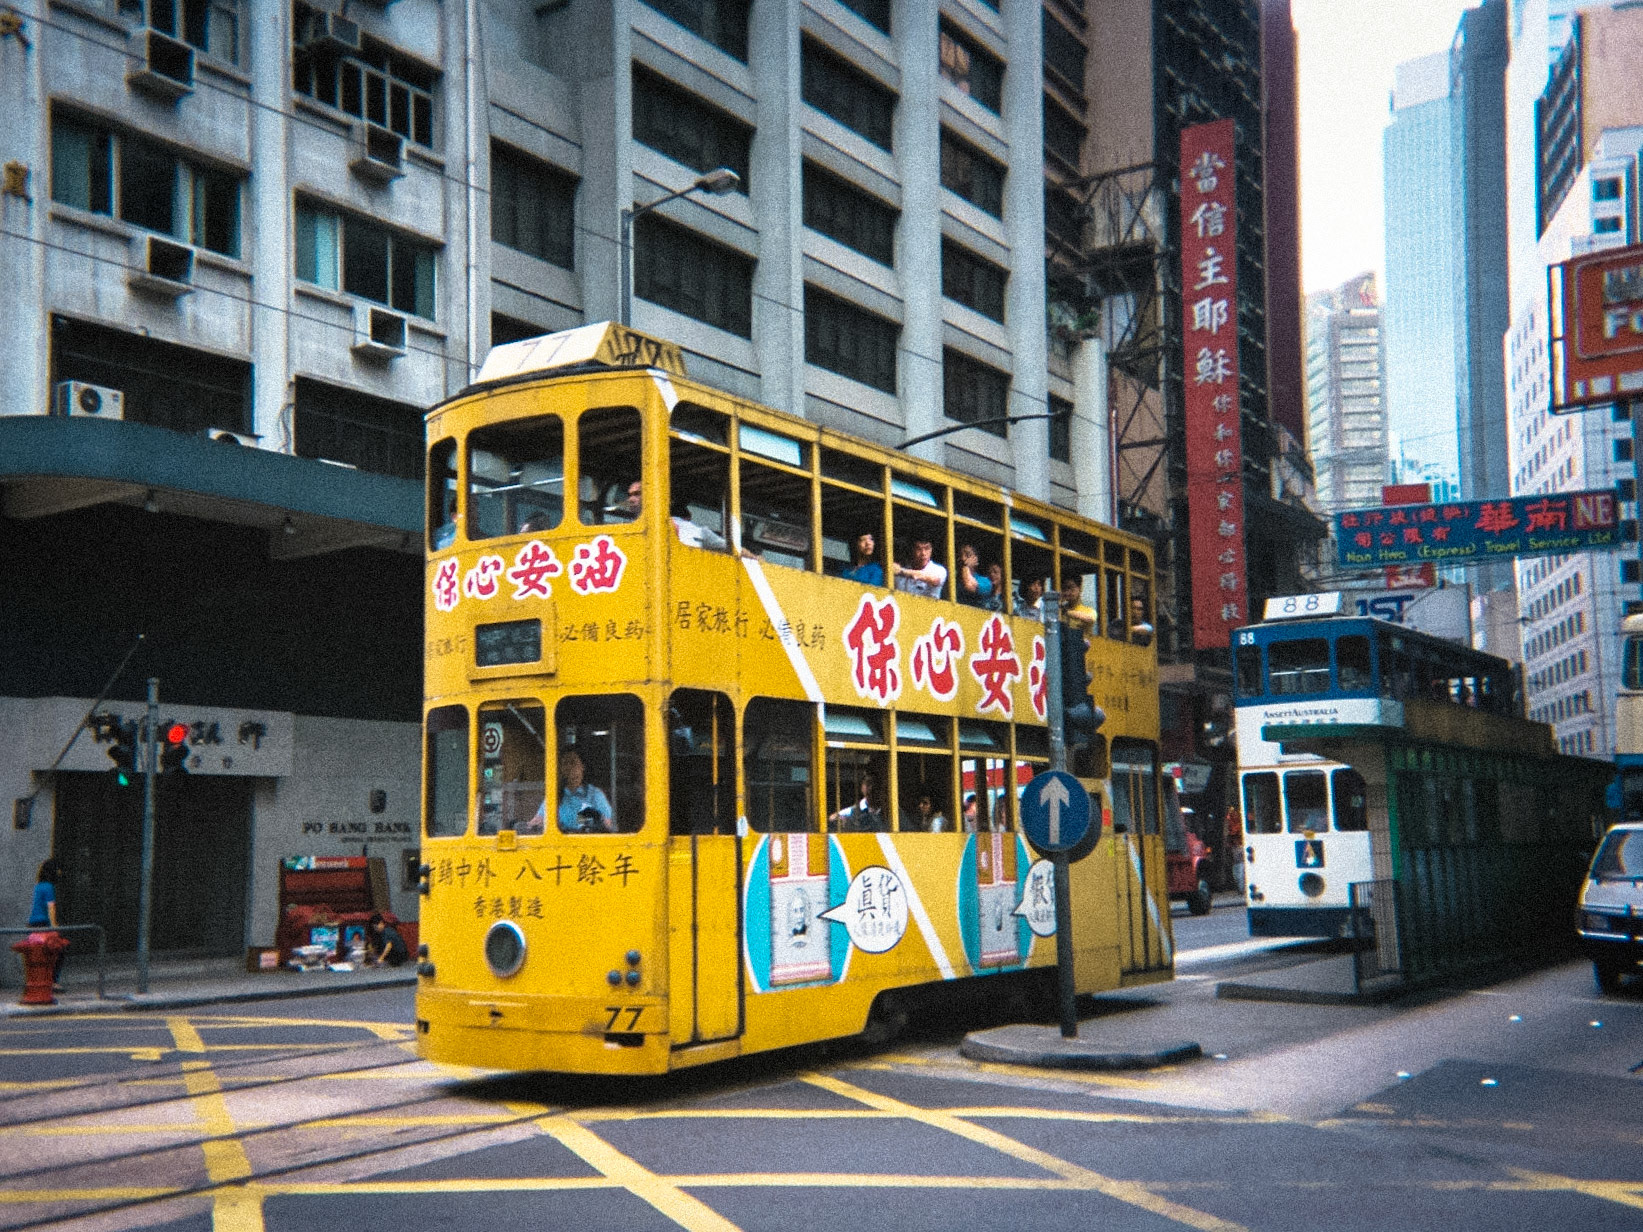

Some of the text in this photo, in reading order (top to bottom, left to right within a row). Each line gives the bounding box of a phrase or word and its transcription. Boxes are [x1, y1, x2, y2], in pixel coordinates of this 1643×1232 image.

[1189, 151, 1234, 385] 當信主耶穌
[515, 333, 573, 370] 77
[1475, 499, 1567, 535] 南華
[1484, 538, 1520, 552] Travel
[1529, 536, 1579, 549] Service
[434, 536, 625, 611] 保心安油
[675, 601, 749, 638] 居家旅行
[1283, 595, 1319, 613] 88
[1240, 632, 1255, 645] 88
[516, 854, 639, 886] 八十餘年
[473, 896, 545, 919] 香港製造
[605, 1007, 644, 1031] 77
